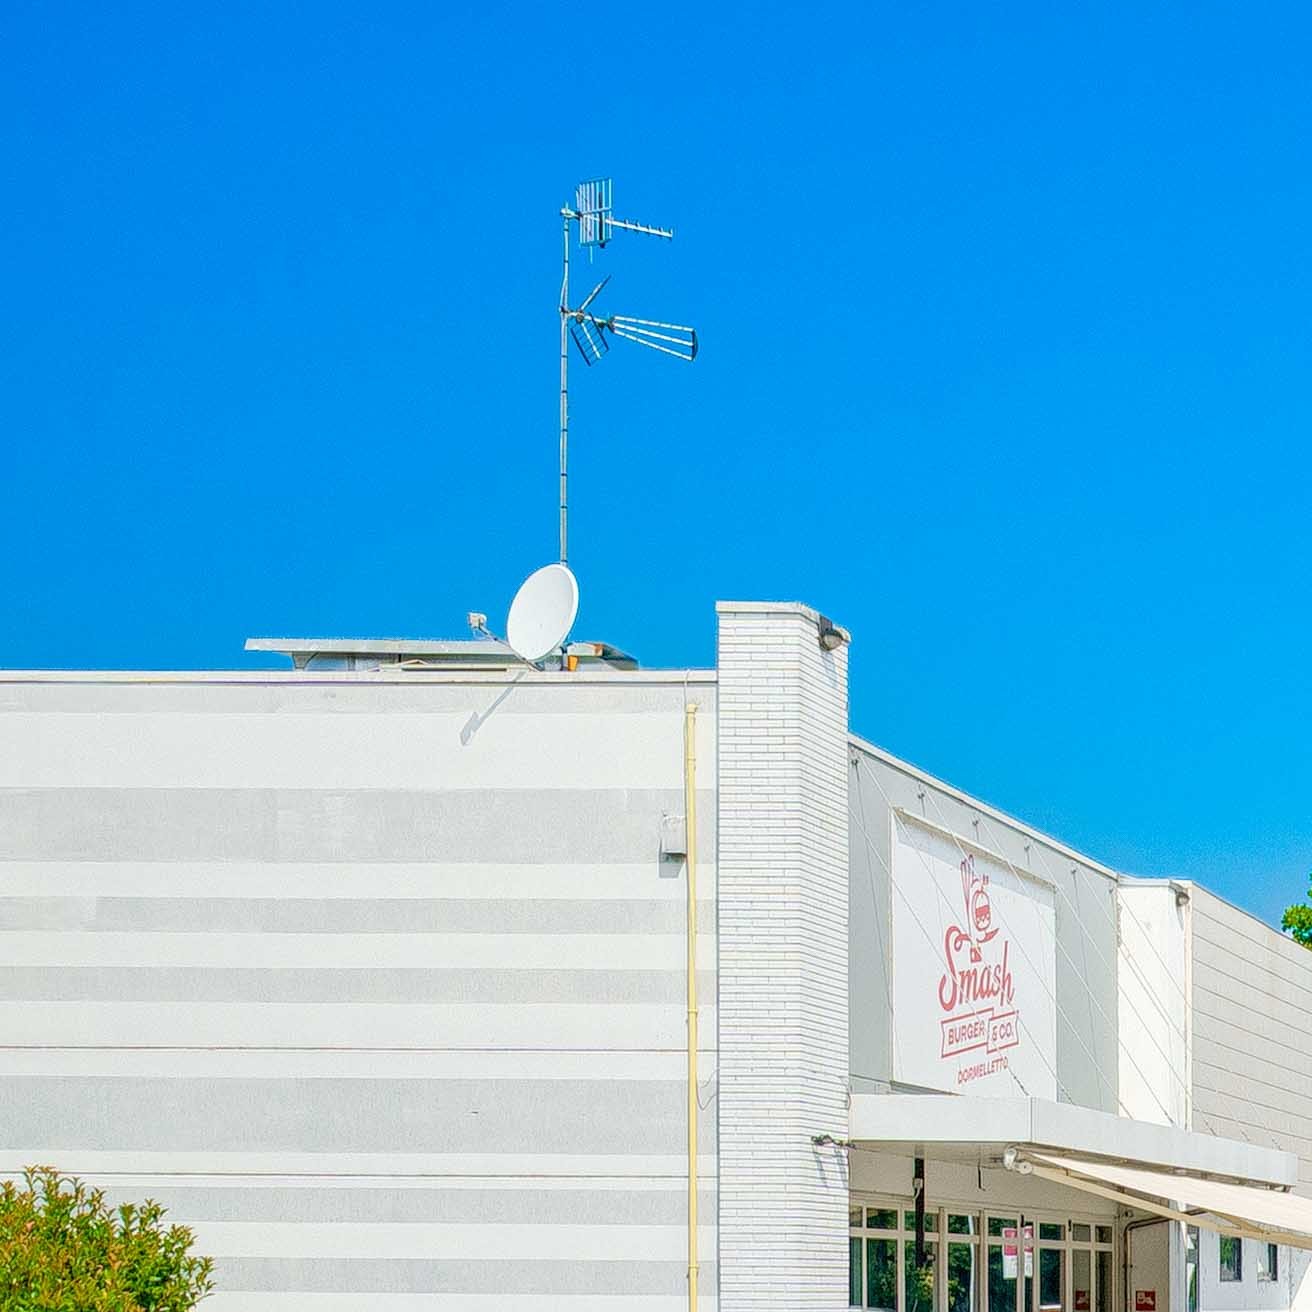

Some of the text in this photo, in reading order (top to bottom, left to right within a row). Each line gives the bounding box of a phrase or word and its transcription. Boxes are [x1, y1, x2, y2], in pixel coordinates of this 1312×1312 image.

[938, 926, 1015, 1011] Smash
[948, 1020, 1014, 1045] BURGER & CO.
[957, 1056, 1009, 1085] DORMELLETTO
